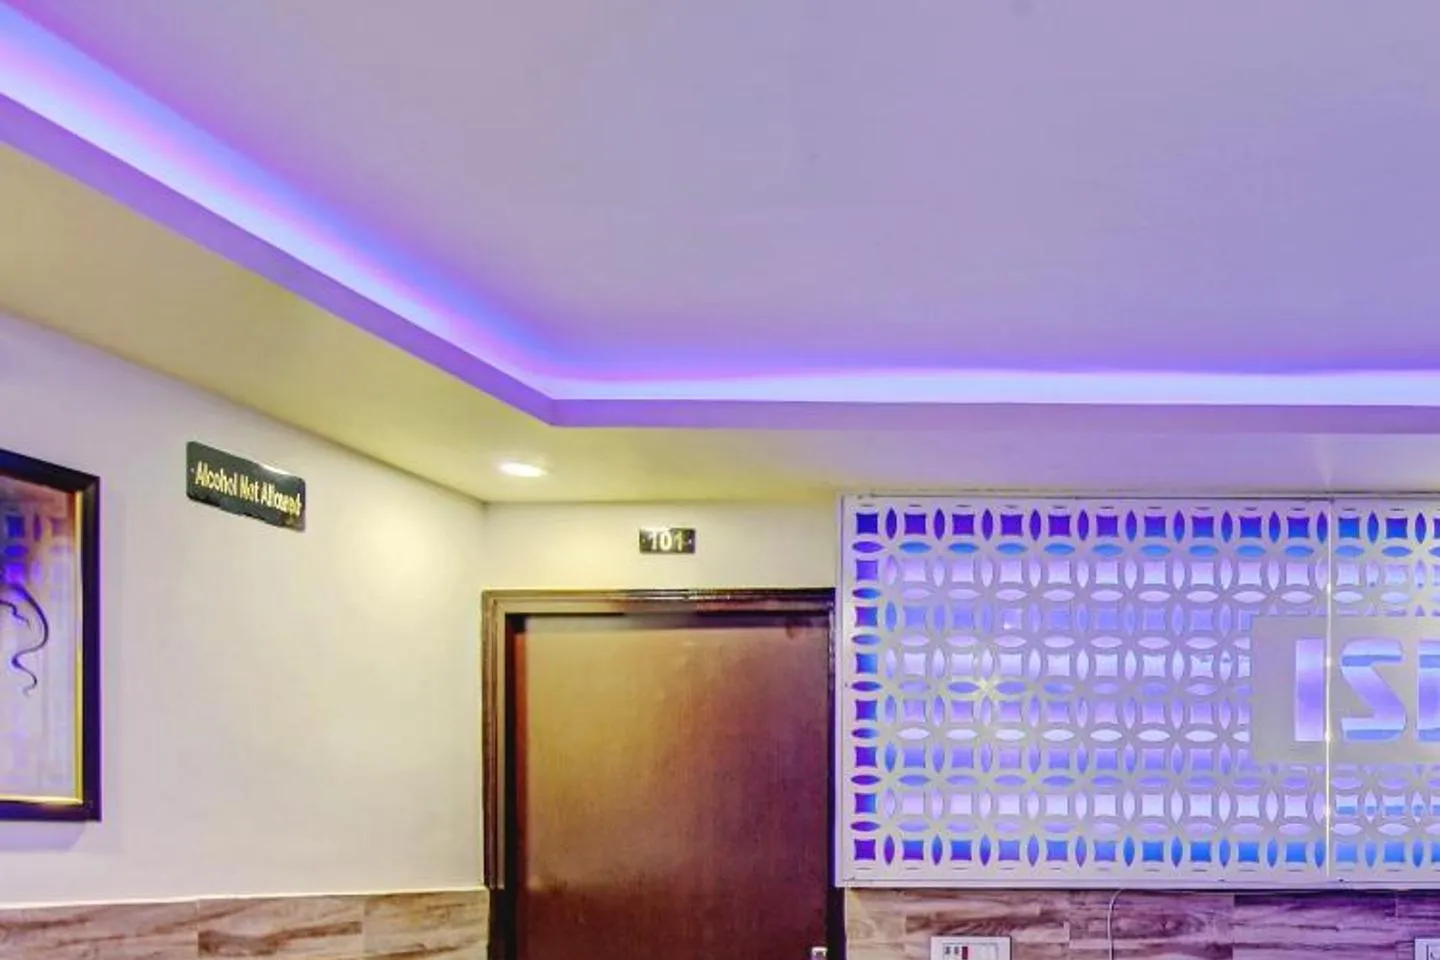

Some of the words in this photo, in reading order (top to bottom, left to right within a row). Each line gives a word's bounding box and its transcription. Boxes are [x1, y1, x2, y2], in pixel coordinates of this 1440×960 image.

[195, 461, 238, 496] Alcohol
[240, 474, 260, 503] Not
[647, 529, 683, 551] 101
